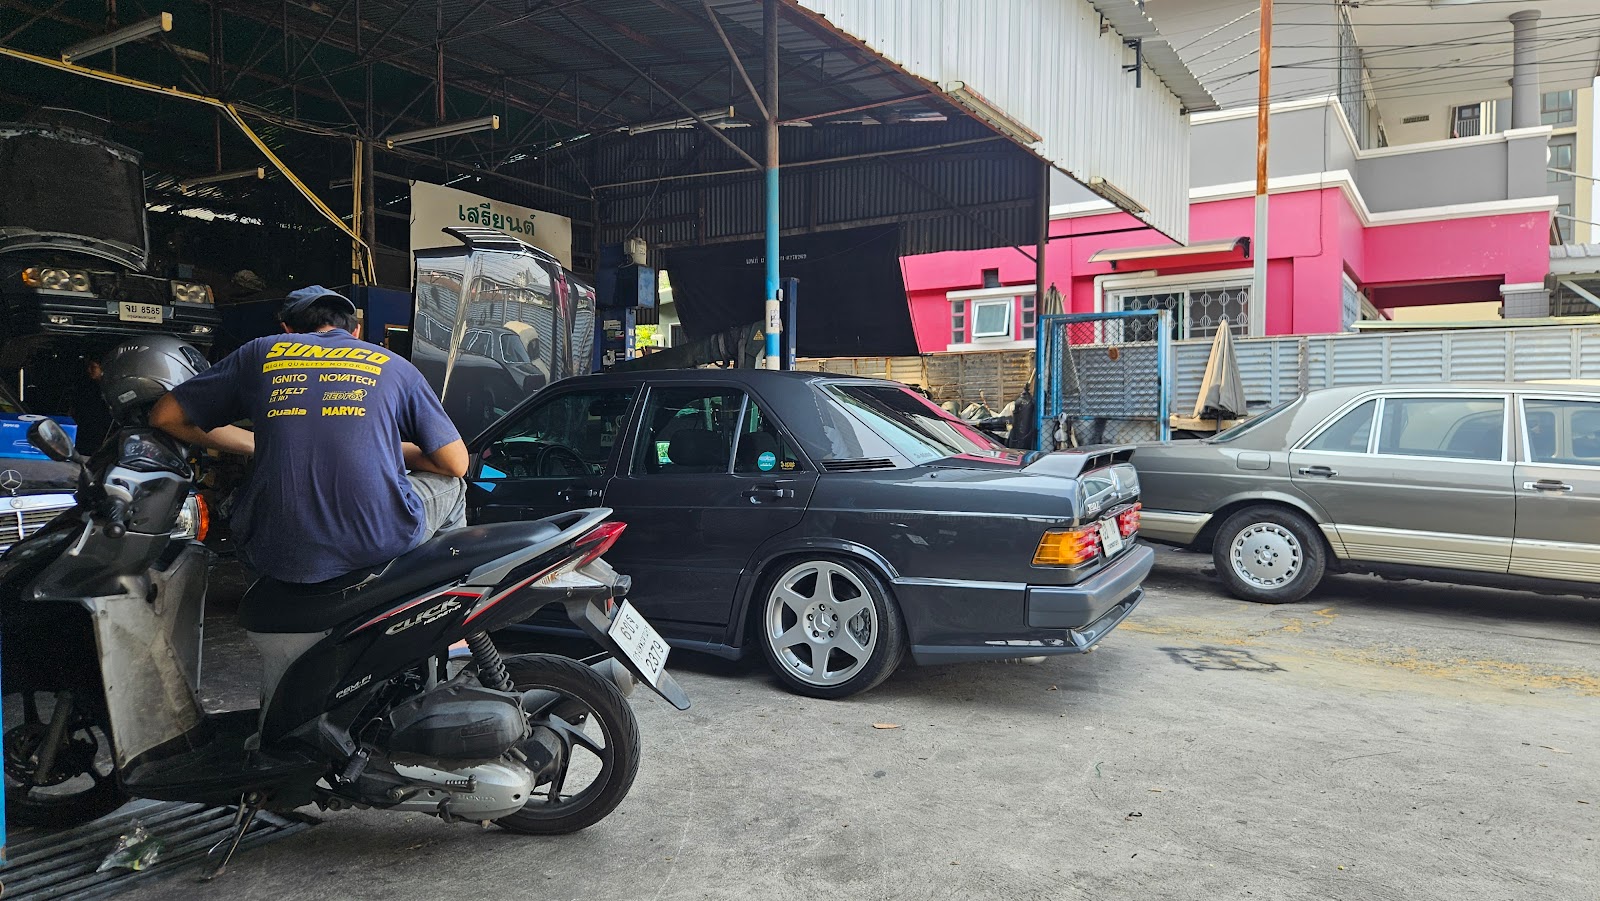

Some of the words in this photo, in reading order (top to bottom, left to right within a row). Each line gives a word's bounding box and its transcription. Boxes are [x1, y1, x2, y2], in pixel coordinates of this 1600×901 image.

[458, 202, 536, 236] เสรียนต์
[141, 305, 161, 315] 8585
[266, 342, 391, 365] SUNOCO
[265, 361, 284, 369] HIGH
[329, 361, 361, 369] MOTOR
[364, 365, 379, 373] OIL
[272, 373, 308, 385] IGNITO
[319, 373, 377, 387] NOVATECH
[271, 387, 308, 397] SVELT
[266, 407, 307, 418] Qualia
[322, 406, 366, 417] MARVIC
[385, 595, 461, 636] CLICK
[645, 640, 664, 674] 2379
